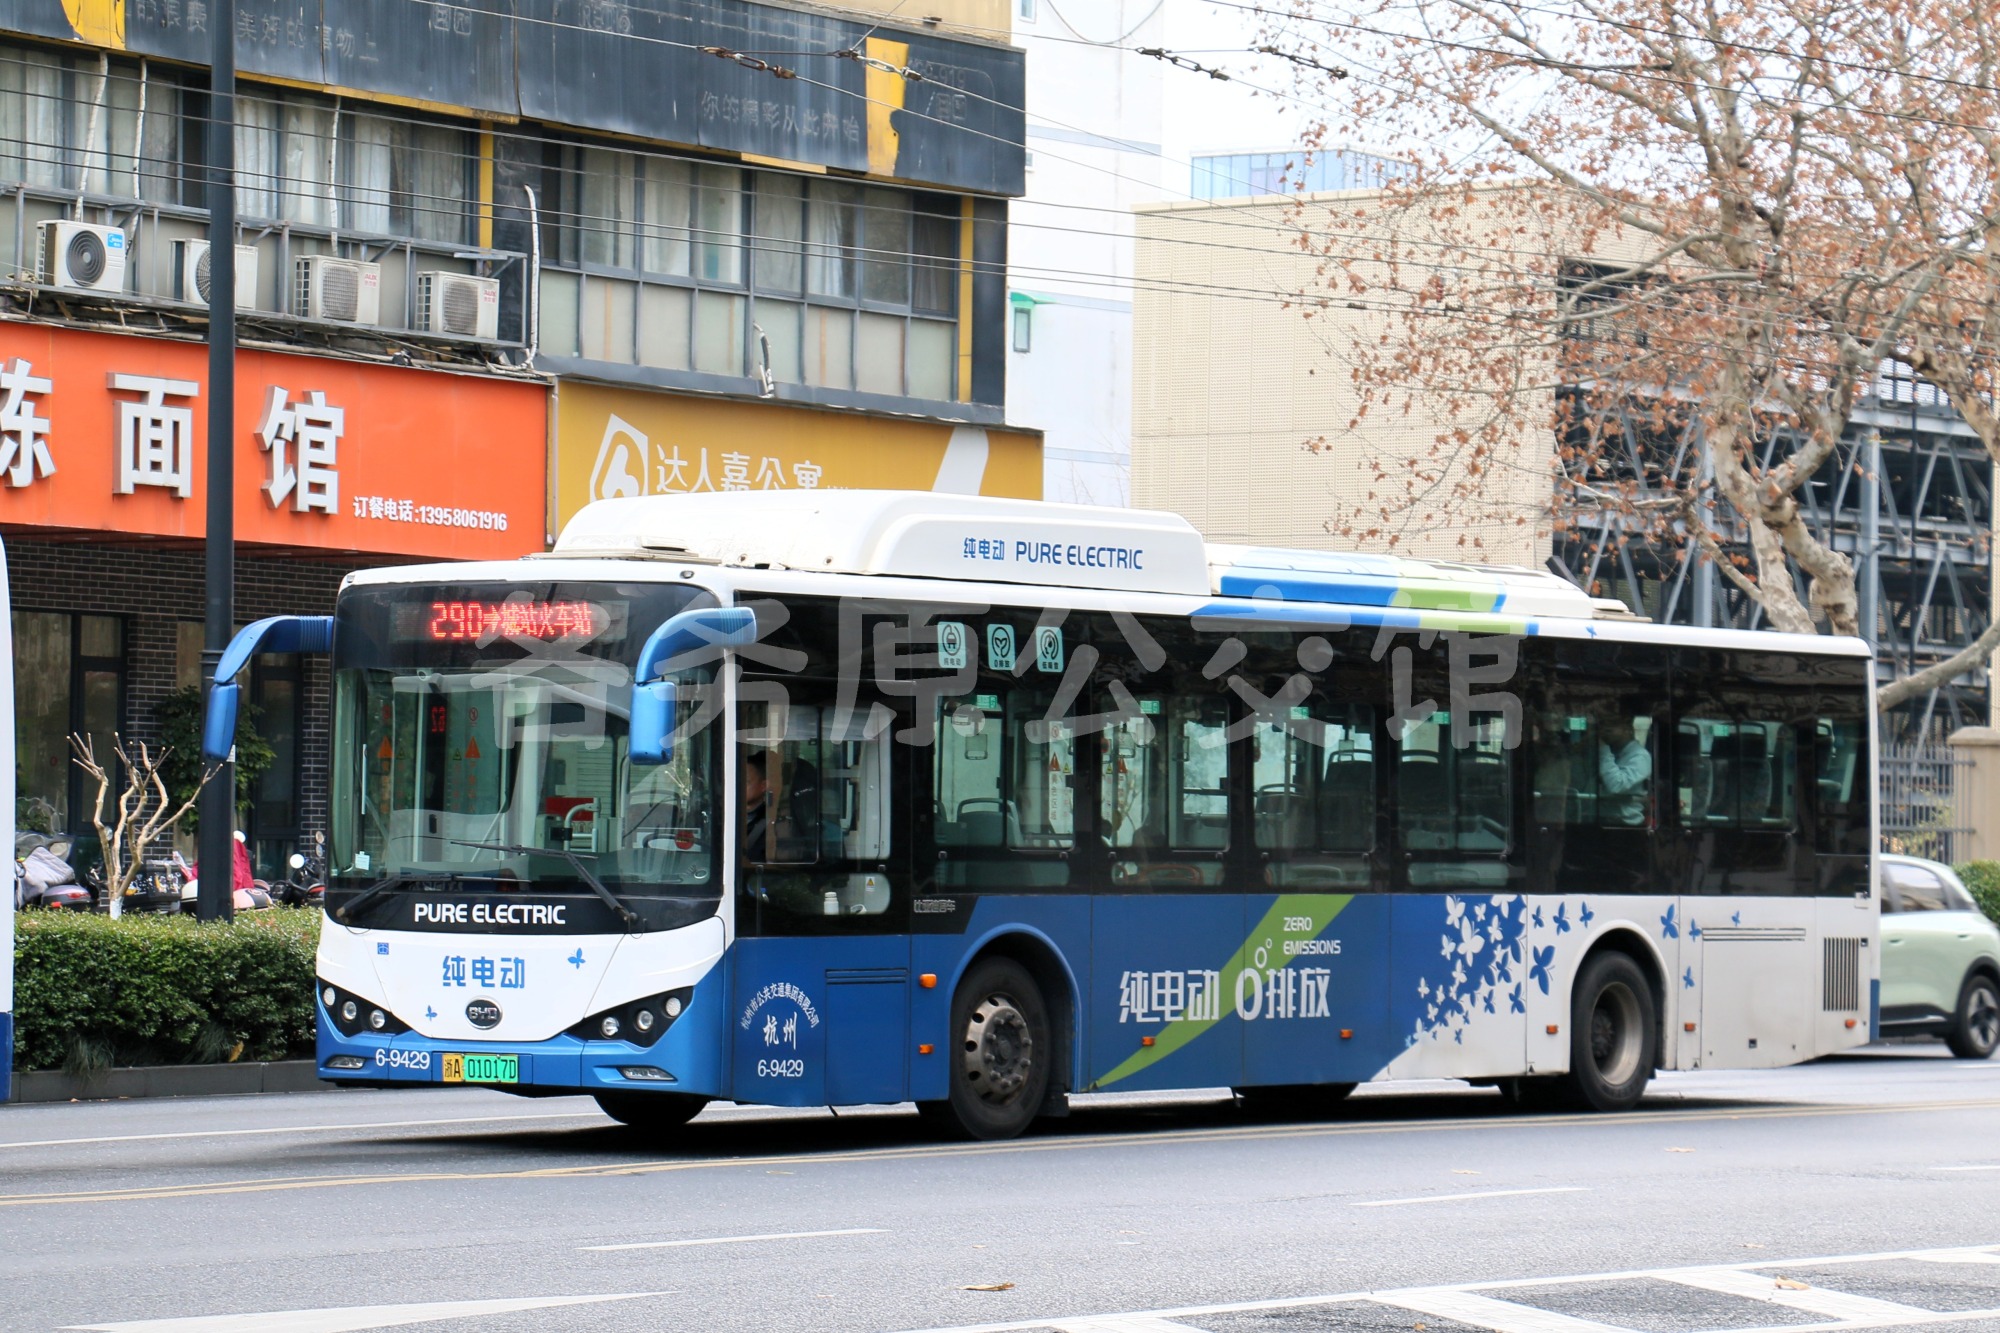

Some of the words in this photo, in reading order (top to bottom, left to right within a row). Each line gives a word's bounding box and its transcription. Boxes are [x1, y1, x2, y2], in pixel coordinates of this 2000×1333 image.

[656, 444, 823, 493] 达人嘉公寓
[963, 537, 1005, 560] 纯电动
[1016, 541, 1062, 564] PURE
[1066, 545, 1143, 569] ELECTRIC
[431, 602, 483, 637] 290
[414, 903, 467, 923] PURE
[472, 904, 566, 924] ELECTRIC
[1283, 917, 1313, 931] ZERO
[1283, 940, 1341, 955] EMISSIONS
[443, 955, 526, 989] 纯电动
[740, 982, 820, 1030] 杭州市公共交通集团有限公司
[1119, 970, 1220, 1023] 纯电动
[469, 1006, 498, 1020] BYD
[763, 1011, 798, 1051] 杭州
[375, 1048, 431, 1070] 6-9429
[757, 1059, 804, 1078] 6-9429
